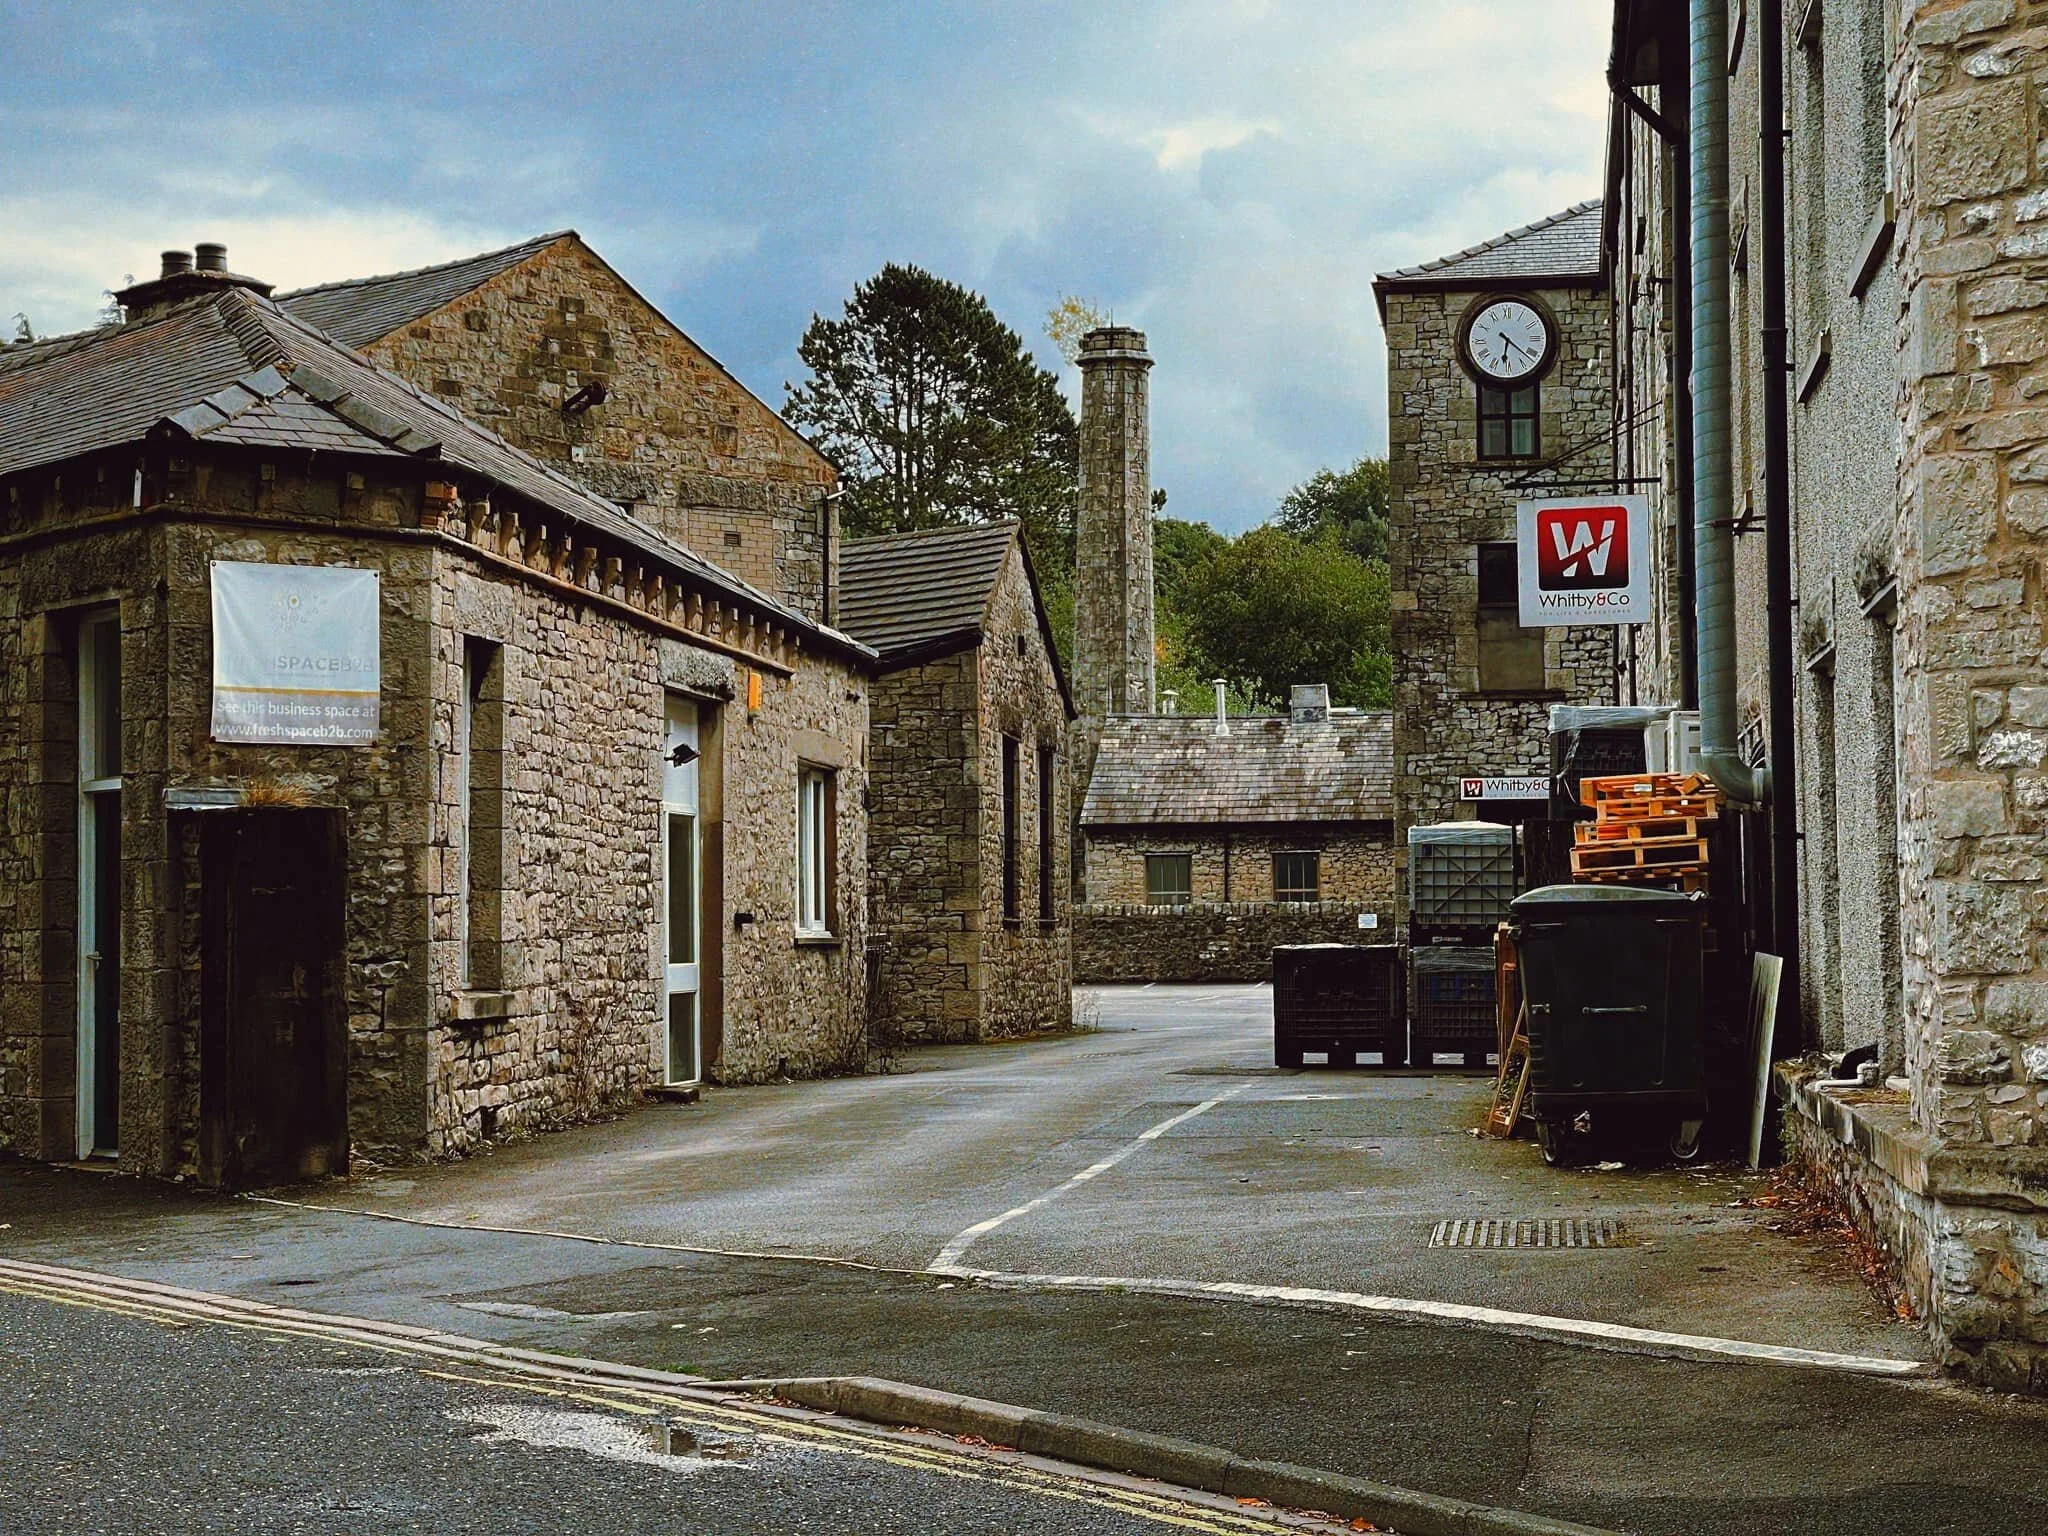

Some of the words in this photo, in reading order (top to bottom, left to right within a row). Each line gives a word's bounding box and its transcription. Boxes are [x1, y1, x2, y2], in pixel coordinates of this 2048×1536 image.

[1502, 306, 1512, 319] XII
[1517, 311, 1524, 322] I
[1539, 591, 1630, 610] Whitby&Co
[216, 701, 241, 714] See
[268, 701, 322, 716] business
[323, 704, 359, 719] space
[362, 704, 376, 718] at
[215, 723, 374, 739] www.freshspaceb2b.com
[1486, 779, 1550, 793] Whitby&C
